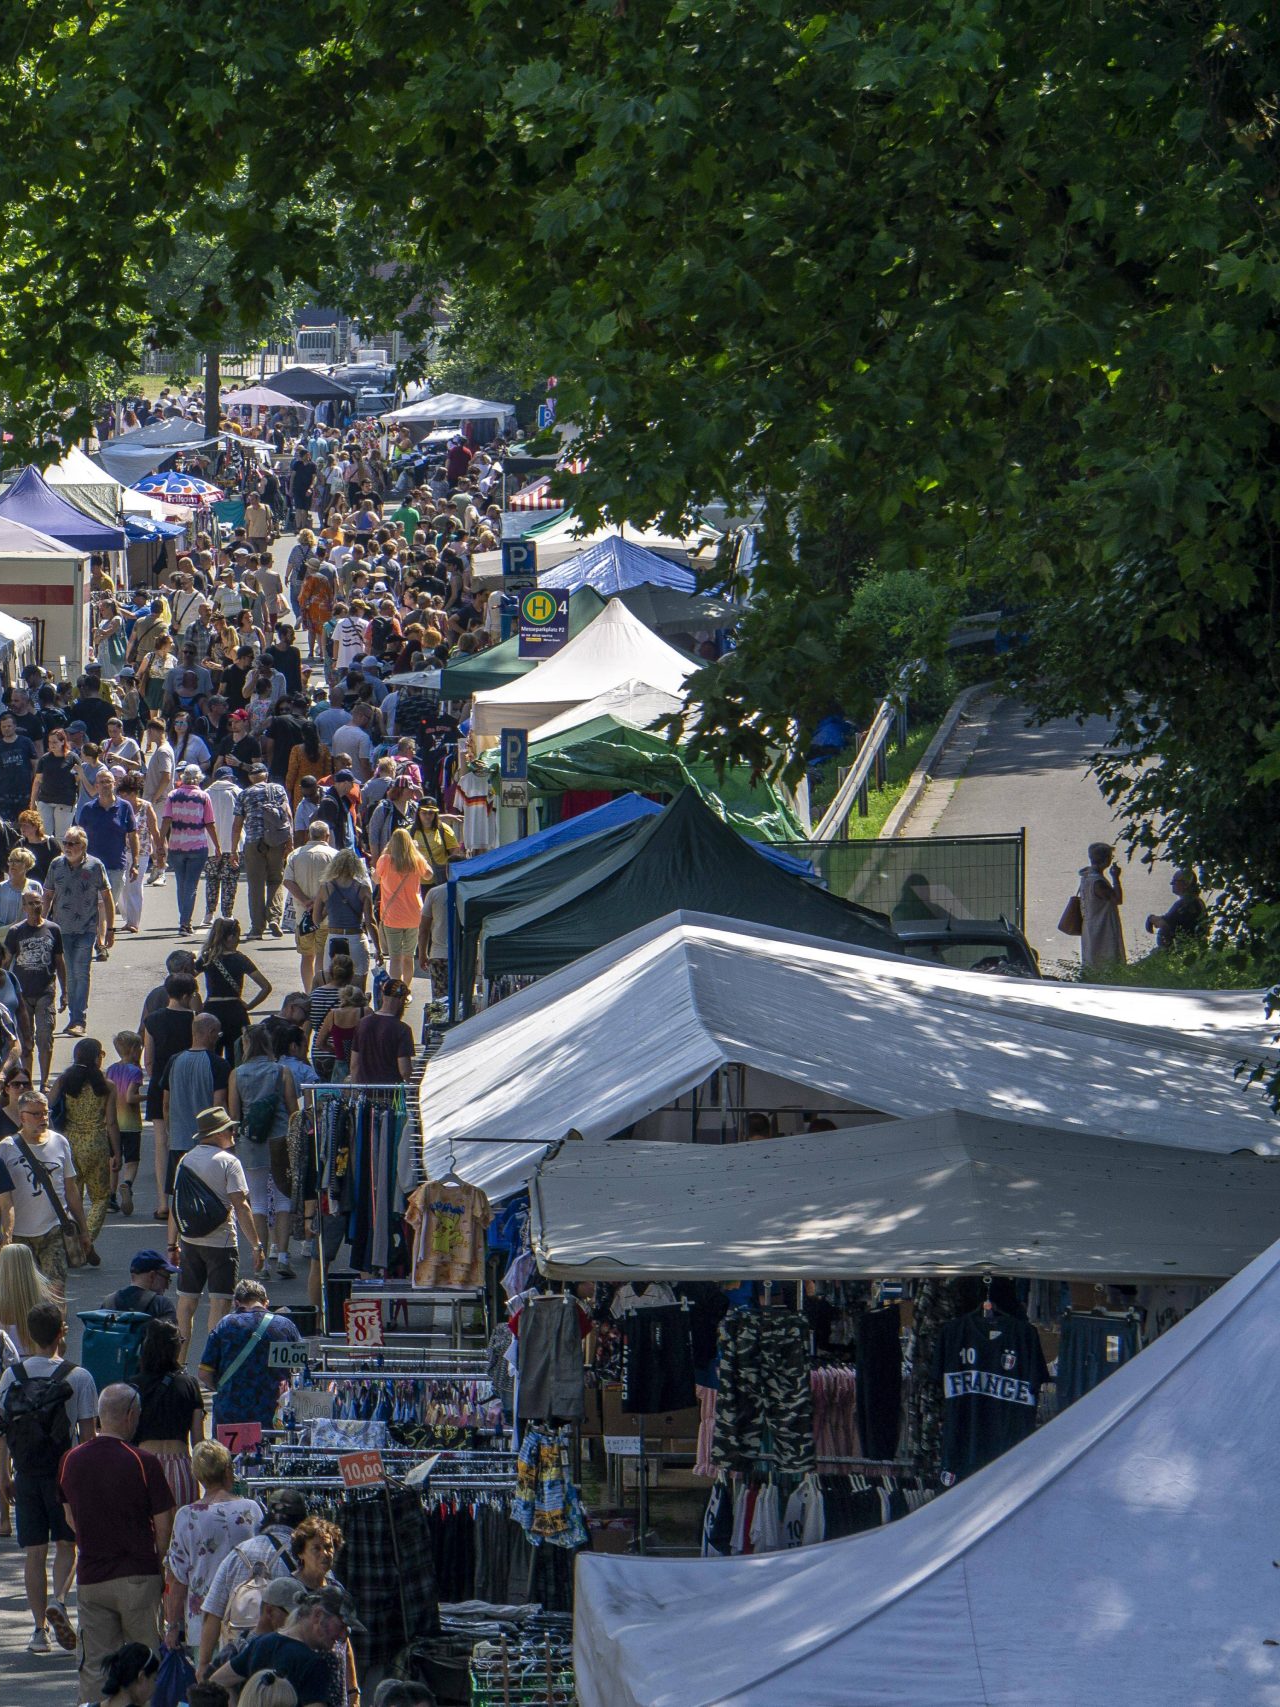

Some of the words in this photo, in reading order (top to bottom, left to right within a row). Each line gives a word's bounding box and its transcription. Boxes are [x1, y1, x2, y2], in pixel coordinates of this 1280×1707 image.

[510, 546, 528, 572] P
[532, 599, 546, 617] H
[558, 600, 568, 615] 4
[506, 735, 522, 773] P
[272, 1347, 308, 1366] 10,00
[959, 1347, 976, 1365] 10
[948, 1373, 1033, 1404] FRANCE
[224, 1432, 239, 1451] 7
[344, 1463, 382, 1482] 10,00
